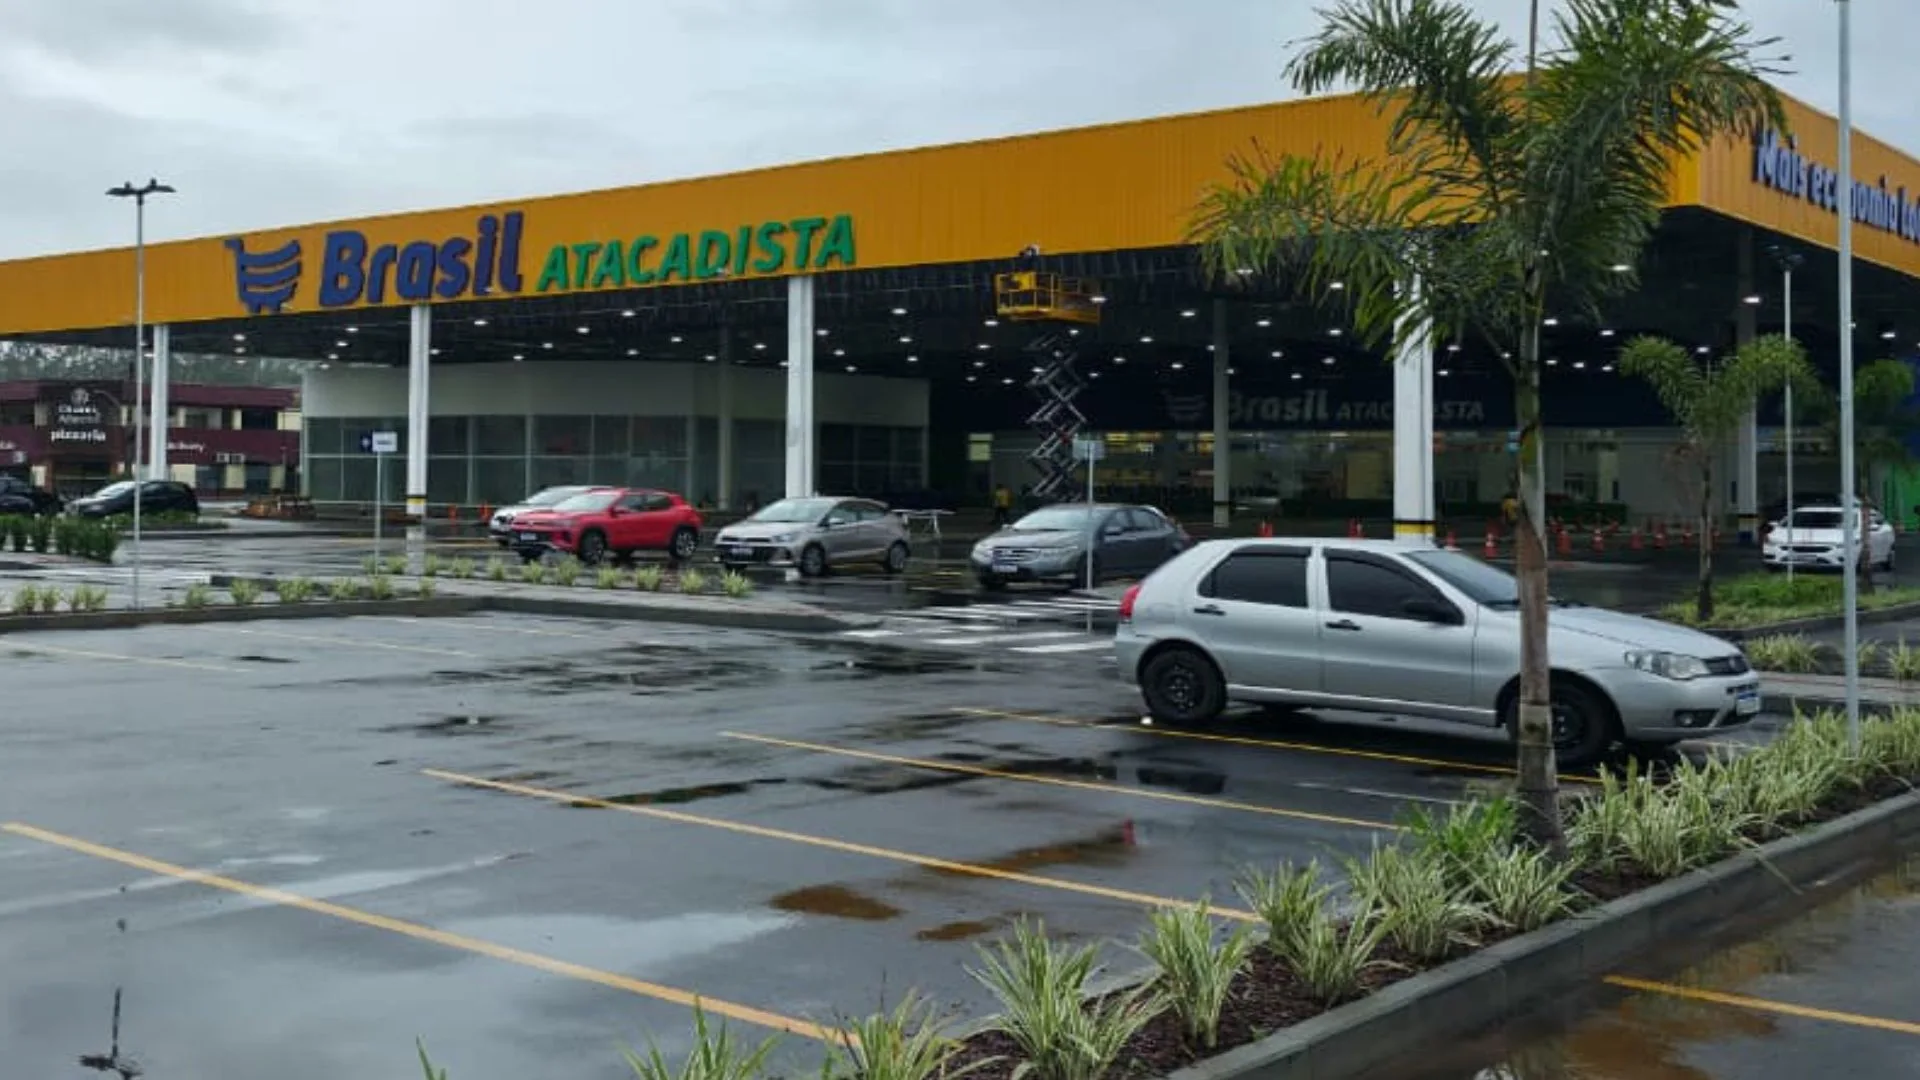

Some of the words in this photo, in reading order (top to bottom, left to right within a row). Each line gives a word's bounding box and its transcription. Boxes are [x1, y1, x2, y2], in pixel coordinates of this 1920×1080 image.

[1753, 126, 1808, 200] Mais
[1808, 162, 1898, 234] ecnomia
[319, 211, 524, 307] Brasil
[539, 212, 857, 292] ATACADISTA
[1337, 399, 1486, 422] ATACSTA
